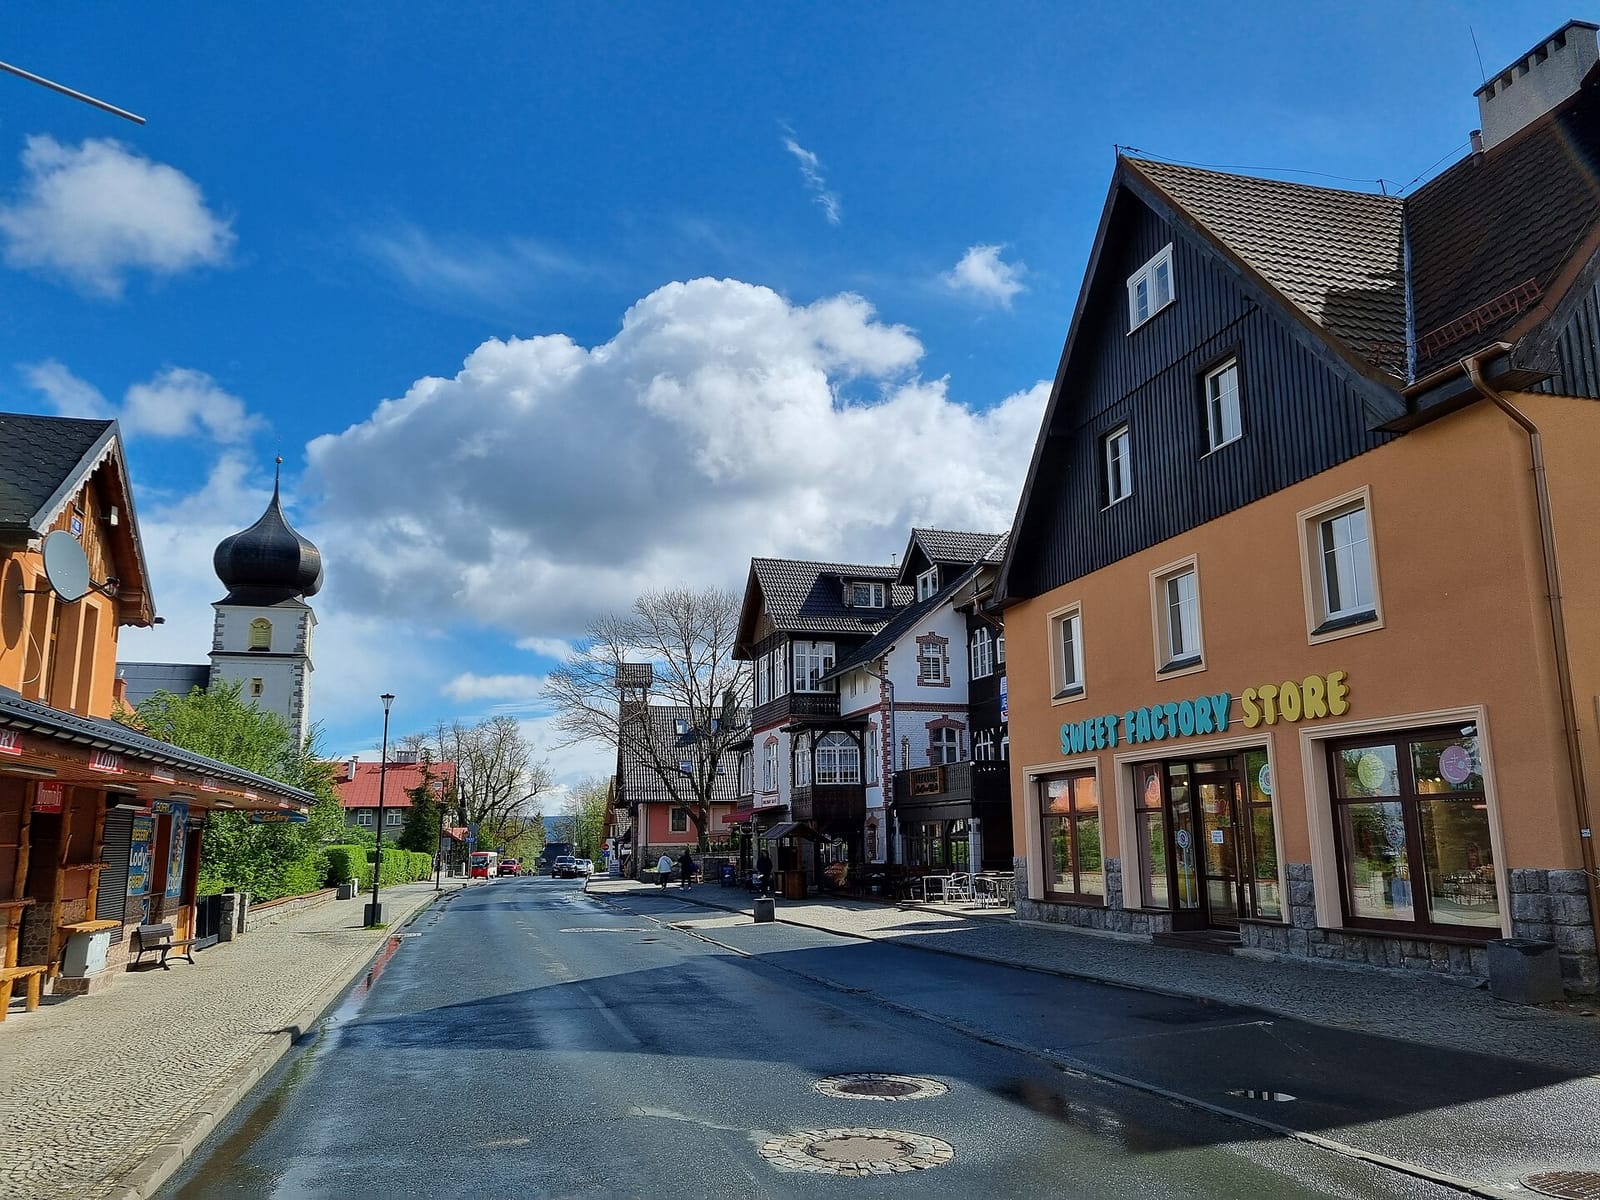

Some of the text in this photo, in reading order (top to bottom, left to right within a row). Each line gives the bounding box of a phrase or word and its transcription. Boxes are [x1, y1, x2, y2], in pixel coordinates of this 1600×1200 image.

[1060, 670, 1350, 755] SWEET FACTORY STORE
[94, 751, 121, 771] LODY
[129, 847, 147, 871] Lody
